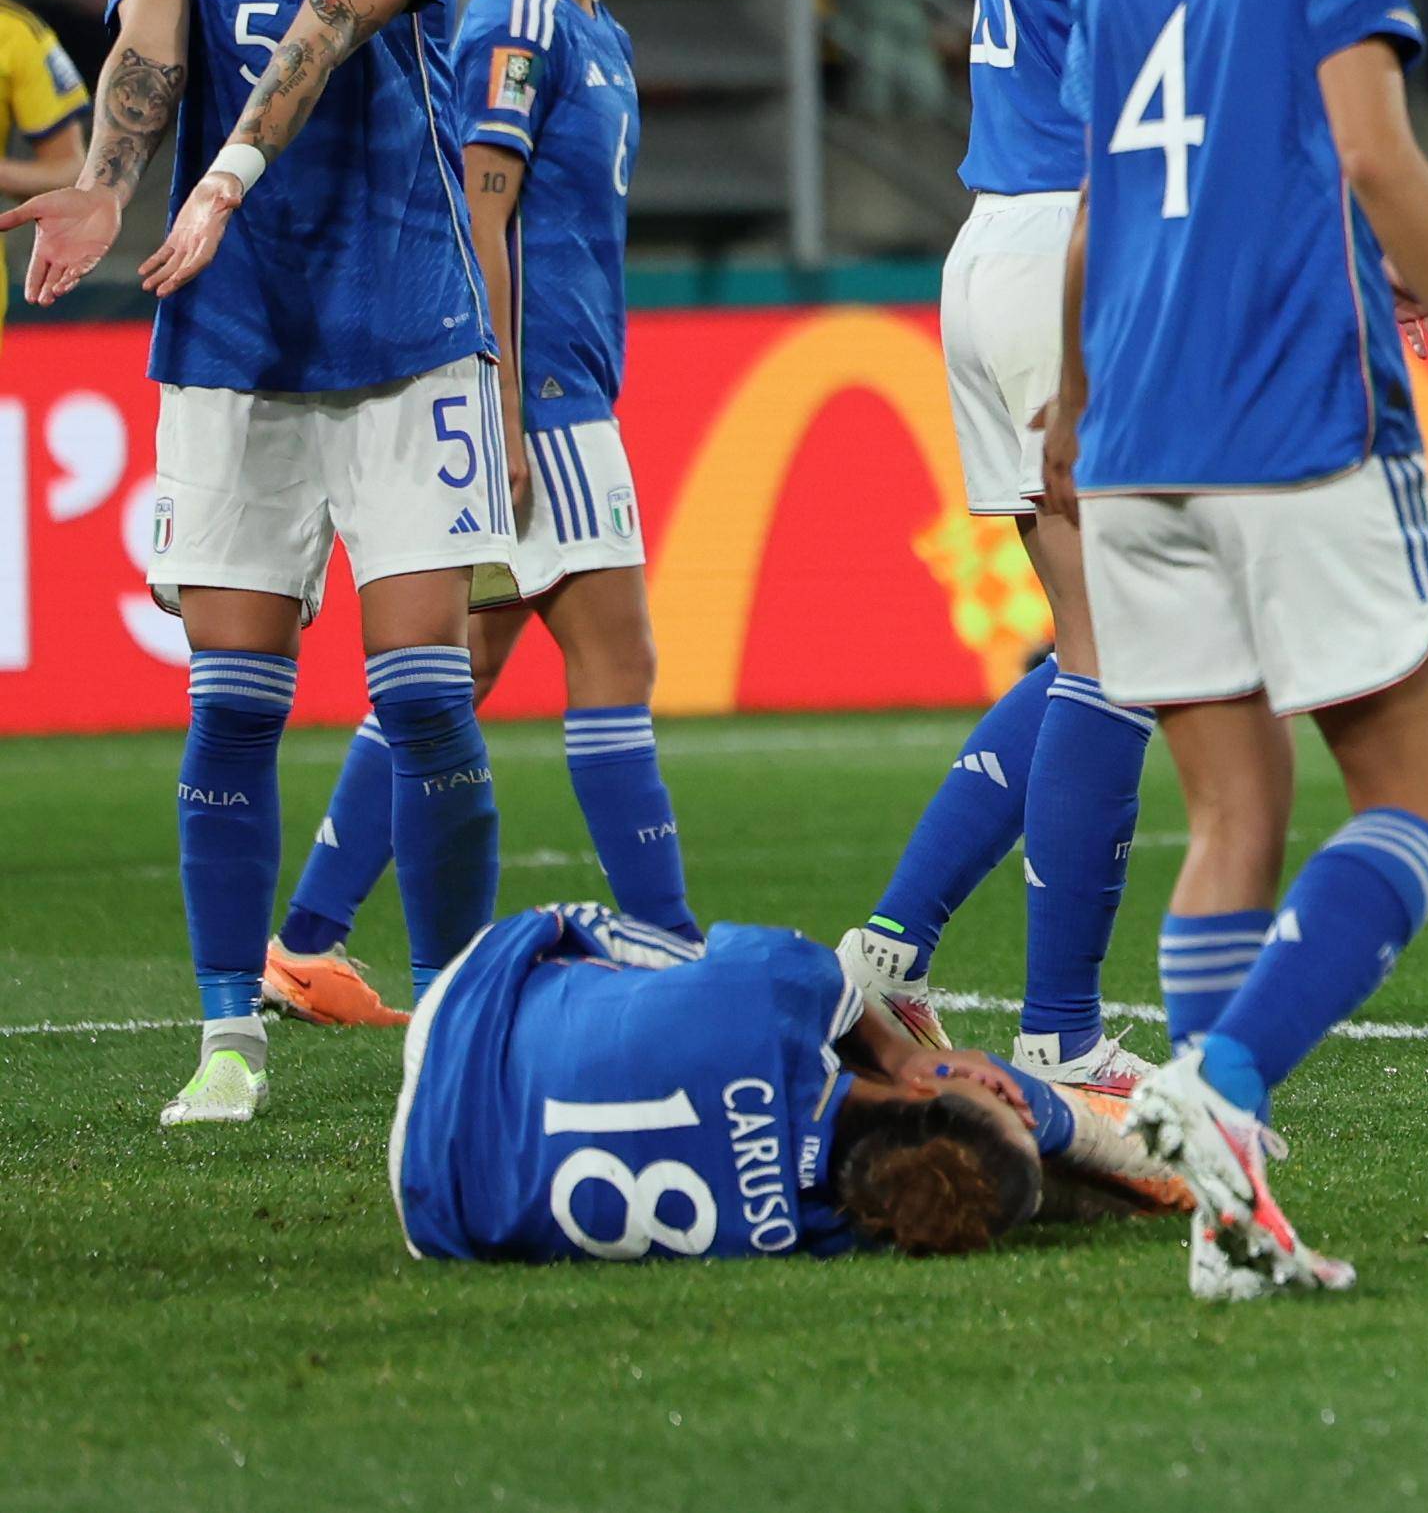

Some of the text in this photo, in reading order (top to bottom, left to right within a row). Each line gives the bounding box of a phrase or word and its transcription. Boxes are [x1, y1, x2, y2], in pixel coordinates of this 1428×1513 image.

[234, 2, 280, 87] 5
[1108, 2, 1206, 219] 4
[480, 172, 507, 194] 10
[432, 395, 477, 488] 5
[178, 781, 250, 806] ITALIA
[422, 766, 494, 797] ITALIA
[543, 1086, 719, 1262] 18
[721, 1077, 799, 1253] CARUSO
[799, 1135, 822, 1190] ITALIA
